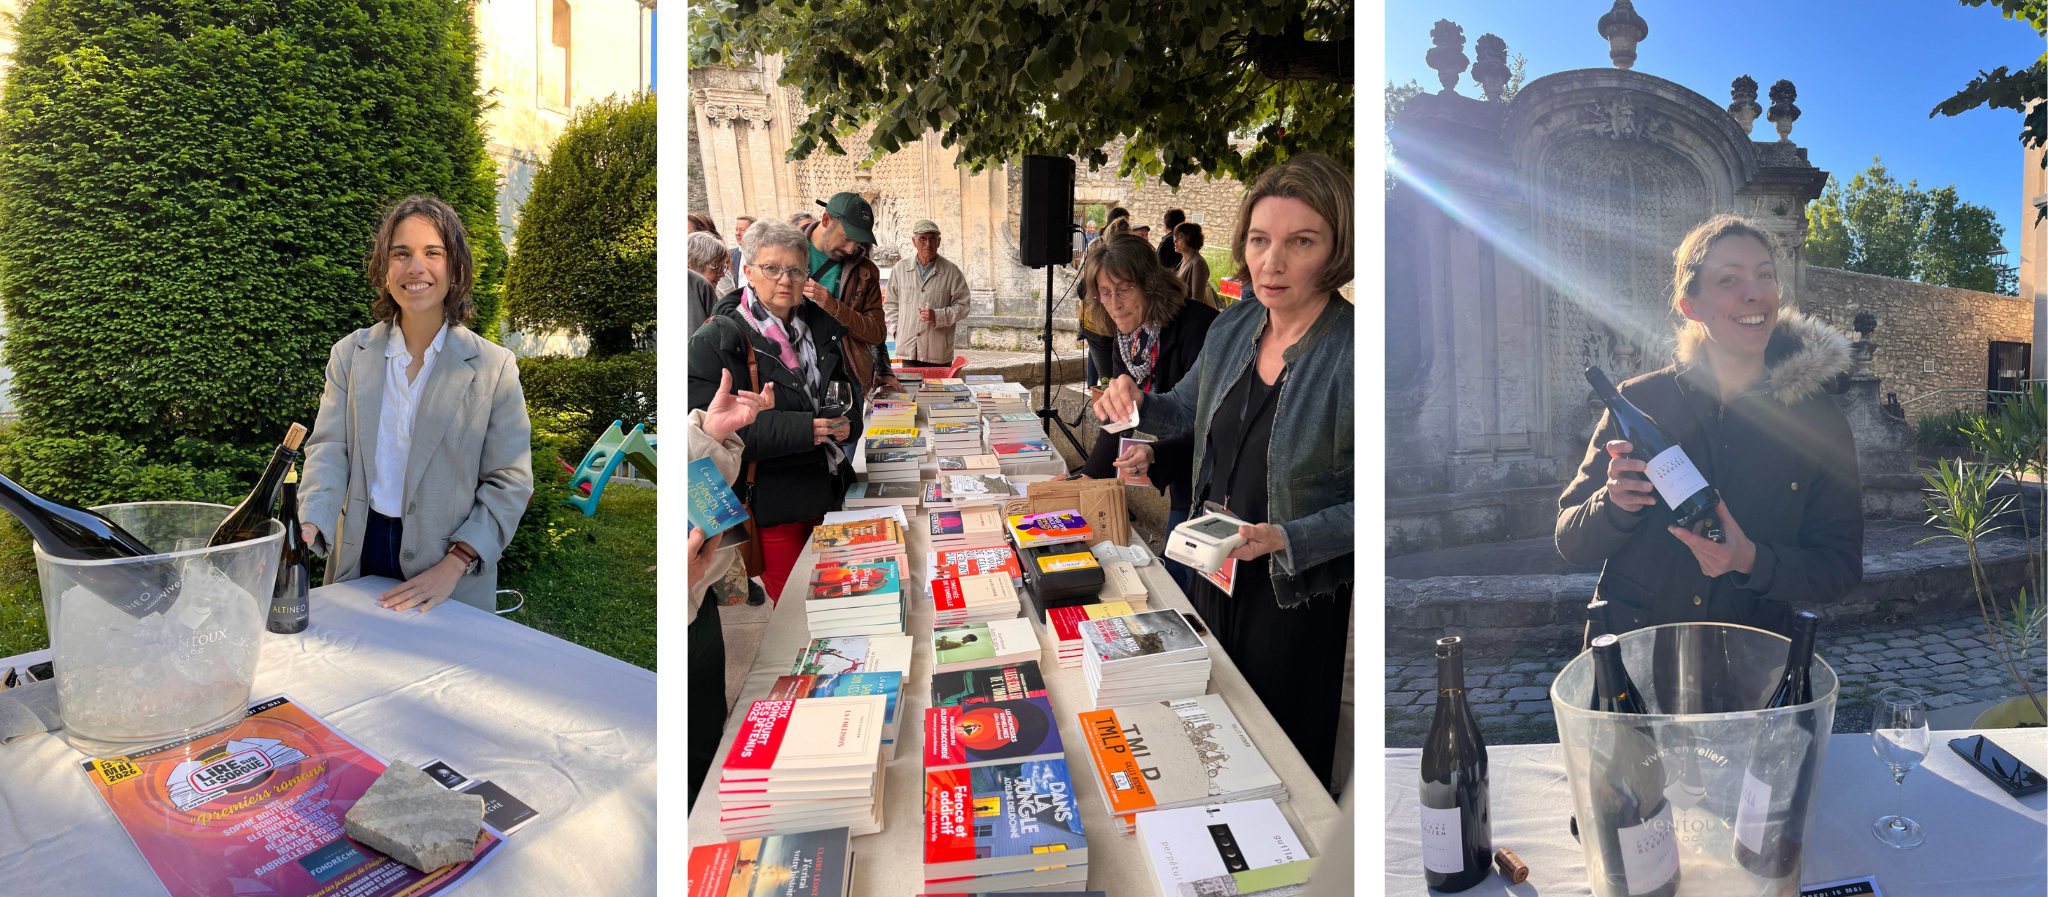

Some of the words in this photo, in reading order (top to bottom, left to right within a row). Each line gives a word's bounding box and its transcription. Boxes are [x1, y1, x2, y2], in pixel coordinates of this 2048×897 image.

[696, 481, 719, 510] DANSER
[700, 467, 718, 490] Laure
[717, 491, 738, 516] Manel
[695, 493, 721, 530] VOLCANS
[850, 566, 858, 583] COMME
[949, 579, 960, 599] TIMOTHÉE
[272, 604, 306, 614] ALTINEO
[878, 675, 890, 694] Laure
[1006, 680, 1023, 700] COULEU
[266, 699, 281, 709] MAI
[748, 700, 763, 723] 2025
[760, 700, 773, 717] DES
[778, 699, 792, 719] PRIX
[843, 709, 851, 718] LA
[758, 700, 782, 746] GONCOURT
[837, 718, 850, 748] COLLISION
[999, 713, 1009, 739] ORPHELINES
[1006, 715, 1018, 742] PROMESSES
[941, 725, 949, 759] DÉSACCORDÉ
[1095, 715, 1126, 758] TMLP
[239, 756, 257, 766] SUR
[1642, 748, 1670, 767] vivez
[1675, 745, 1689, 754] en
[1693, 747, 1728, 767] relief!
[104, 762, 132, 777] MAI
[108, 768, 137, 782] 2026
[204, 778, 217, 788] LA
[215, 759, 265, 785] SORGUE
[1124, 760, 1137, 776] GILLES
[1131, 776, 1146, 796] ROCHIER
[1004, 777, 1013, 800] ADELINE
[1050, 781, 1073, 822] DANS
[253, 814, 281, 832] ROBIN
[280, 797, 314, 819] CONCHE
[264, 798, 281, 810] AVEC
[293, 798, 331, 821] GALASSO
[940, 790, 955, 835] addictif
[954, 785, 967, 823] Féroce
[1014, 777, 1039, 834] JUNGLE
[1033, 794, 1053, 814] LA
[222, 817, 257, 837] SOPHIE
[264, 830, 300, 852] RÉJANE
[299, 812, 338, 836] LACOSTE
[265, 826, 290, 843] PAUL
[290, 809, 326, 831] GASNIER
[955, 825, 967, 838] et
[1006, 800, 1020, 839] DIEUDONNÉ
[276, 833, 314, 856] MAXIME
[313, 820, 340, 838] ROSSI
[254, 847, 305, 877] GABRIELLE
[304, 840, 319, 852] DE
[317, 826, 347, 845] TOURN
[309, 847, 358, 877] FONDRÈCHE
[790, 850, 801, 870] votre
[815, 847, 824, 873] CLAIRE
[1162, 841, 1185, 885] perpétui
[332, 871, 357, 889] jardins
[786, 871, 800, 897] histoir
[799, 858, 812, 889] J'écrirai
[811, 873, 822, 897] LÉOST
[340, 887, 349, 895] LA
